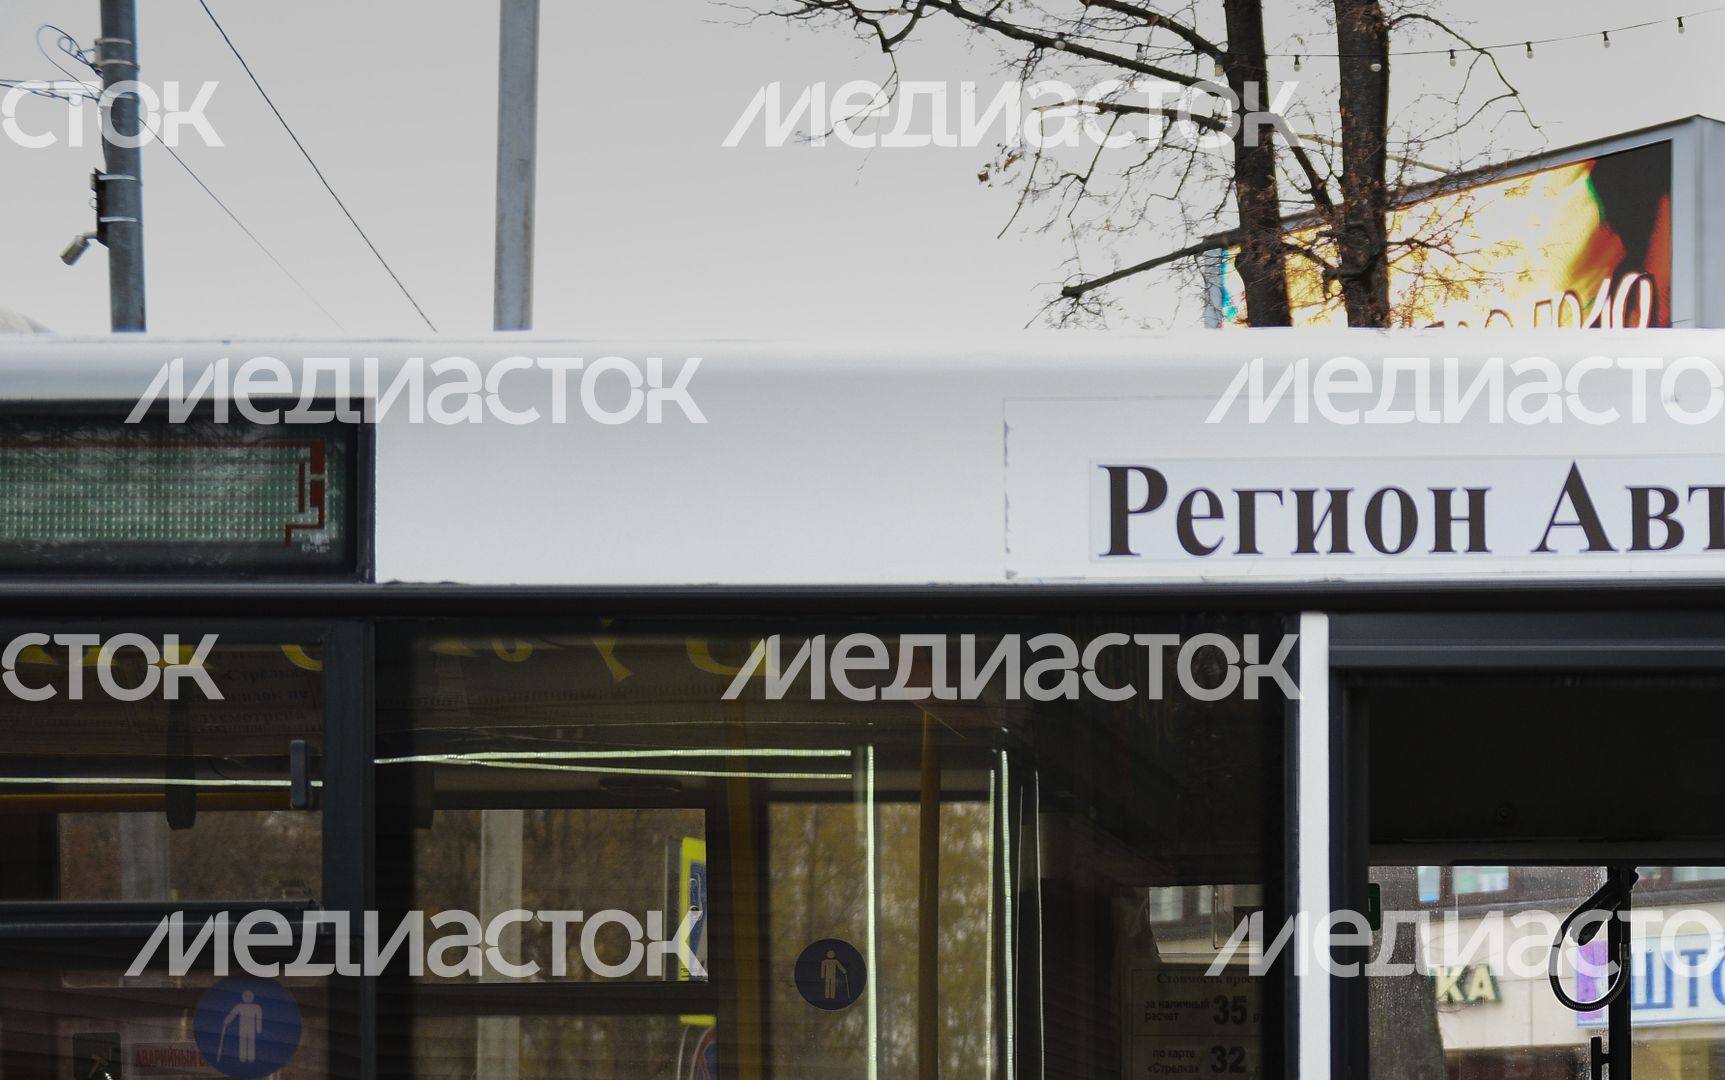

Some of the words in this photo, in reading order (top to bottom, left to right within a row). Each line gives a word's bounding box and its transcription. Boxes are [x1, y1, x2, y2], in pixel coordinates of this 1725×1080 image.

[1098, 463, 1493, 559] Регион
[1213, 995, 1248, 1026] 35
[1210, 1045, 1247, 1074] 32
